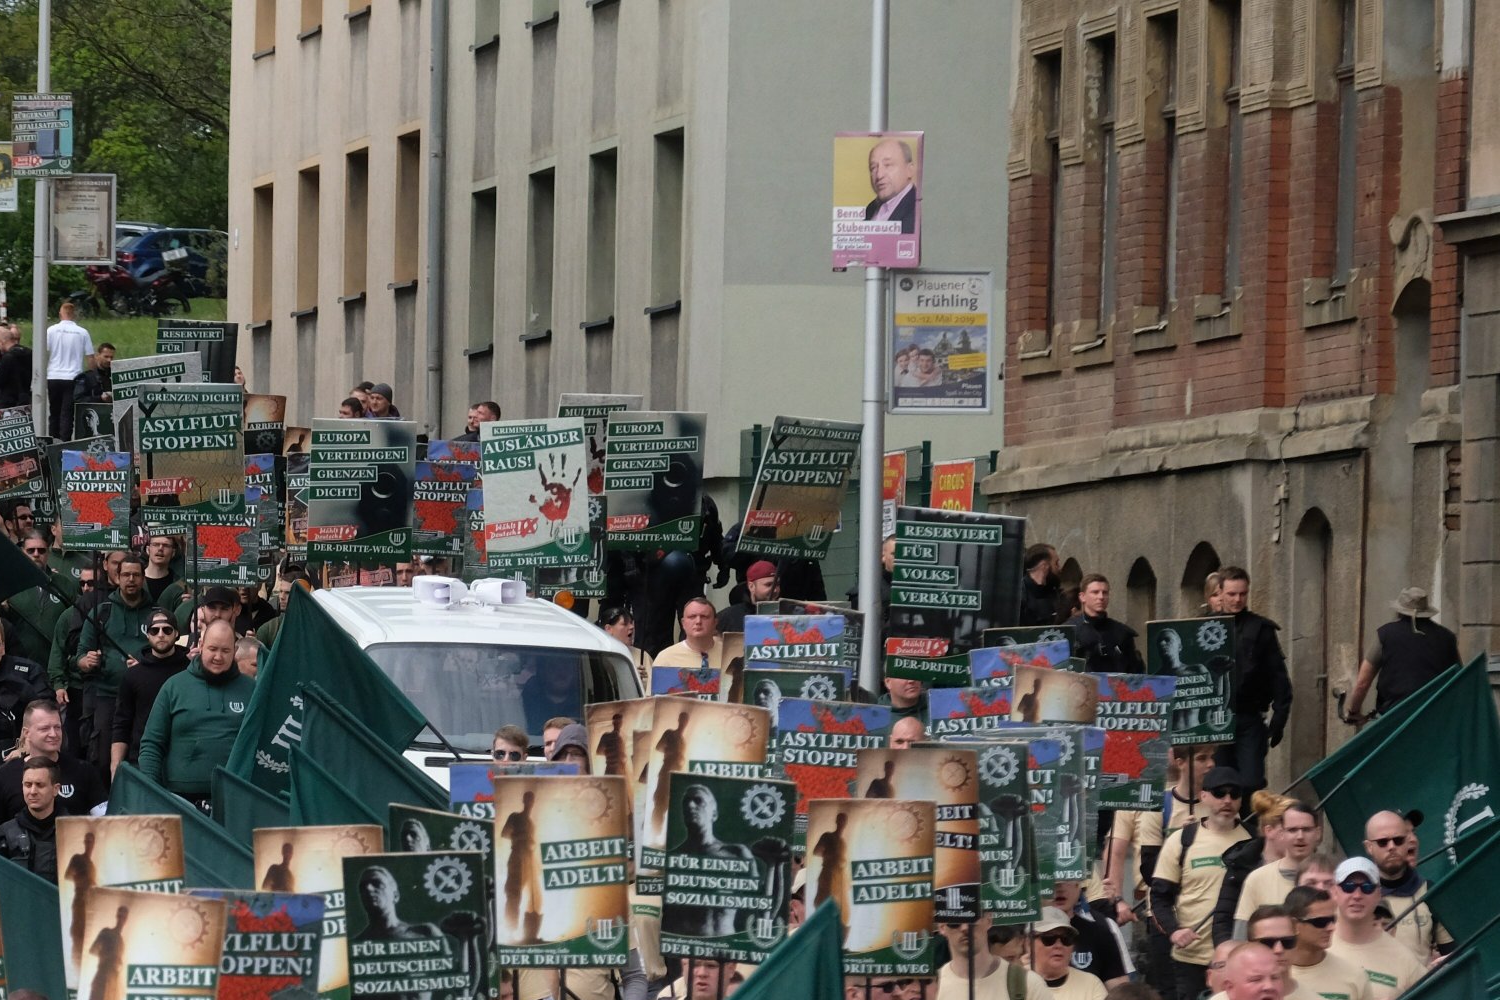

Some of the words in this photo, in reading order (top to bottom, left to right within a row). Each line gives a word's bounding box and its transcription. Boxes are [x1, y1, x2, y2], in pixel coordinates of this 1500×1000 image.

[836, 208, 866, 218] Bernd
[836, 222, 901, 233] Stubenrauch
[916, 279, 966, 290] Plauener
[916, 294, 978, 311] Frühling
[935, 315, 953, 323] Mai
[954, 316, 975, 325] 2019
[162, 330, 222, 339] RESERVIERT
[161, 343, 181, 352] FÜR
[118, 364, 184, 382] MULTIKULTI
[146, 392, 200, 402] GRENZEN
[202, 393, 240, 402] DICHT!
[141, 413, 238, 434] ASYLFLUT
[493, 425, 546, 435] KRIMINELLE
[615, 423, 662, 433] EUROPA
[318, 433, 369, 442] EUROPA
[779, 424, 826, 436] GRENZEN
[826, 429, 860, 441] DICHT!
[141, 434, 234, 450] STOPPEN!
[483, 429, 580, 455] AUSLÄNDER
[614, 440, 696, 452] VERTEIDIGEN!
[318, 450, 405, 461] VERTEIDIGEN!
[765, 450, 853, 466] ASYLFLUT
[484, 456, 532, 471] RAUS!
[612, 459, 667, 470] GRENZEN
[64, 471, 128, 481] ASYLFLUT
[317, 469, 375, 478] GRENZEN
[760, 468, 843, 485] STOPPEN!
[66, 482, 126, 493] STOPPEN!
[413, 481, 472, 491] ASYLFLUT
[611, 477, 651, 488] DICHT!
[939, 473, 965, 491] CIRCUS
[315, 488, 358, 497] DICHT!
[144, 513, 166, 521] DER
[171, 513, 213, 521] DRITTE
[217, 513, 244, 522] WEG
[904, 525, 998, 541] RESERVIERT
[739, 542, 760, 552] DER
[764, 545, 800, 557] DRITTE
[803, 549, 826, 559] WEG
[902, 543, 933, 558] FÜR
[489, 557, 512, 567] DER
[517, 556, 558, 566] DRITTE
[563, 554, 589, 564] WEG
[901, 567, 955, 582] VOLKS-
[899, 589, 978, 606] VERRÄTER
[749, 643, 839, 660] ASYLFLUT
[781, 730, 884, 750] ASYLFLUT
[1210, 733, 1234, 741] WEG
[691, 762, 763, 778] ARBEIT
[543, 838, 625, 862] ARBEIT
[668, 855, 700, 870] FÜR
[704, 857, 750, 872] EINEN
[853, 857, 933, 878] ARBEIT
[547, 866, 625, 887] ADELT!
[667, 875, 760, 891] DEUTSCHEN
[856, 882, 932, 903] ADELT!
[666, 892, 773, 910] SOZIALISMUS!
[352, 940, 386, 956] FÜR
[387, 939, 441, 955] EINEN
[660, 943, 690, 955] DER
[353, 957, 453, 976] DEUTSCHEN
[500, 954, 536, 965] DER
[538, 954, 589, 965] DRITTE
[592, 954, 627, 965] WEG
[896, 962, 930, 974] WEG
[129, 967, 216, 986] ARBEIT
[354, 975, 471, 994] SOZIALISMUS!
